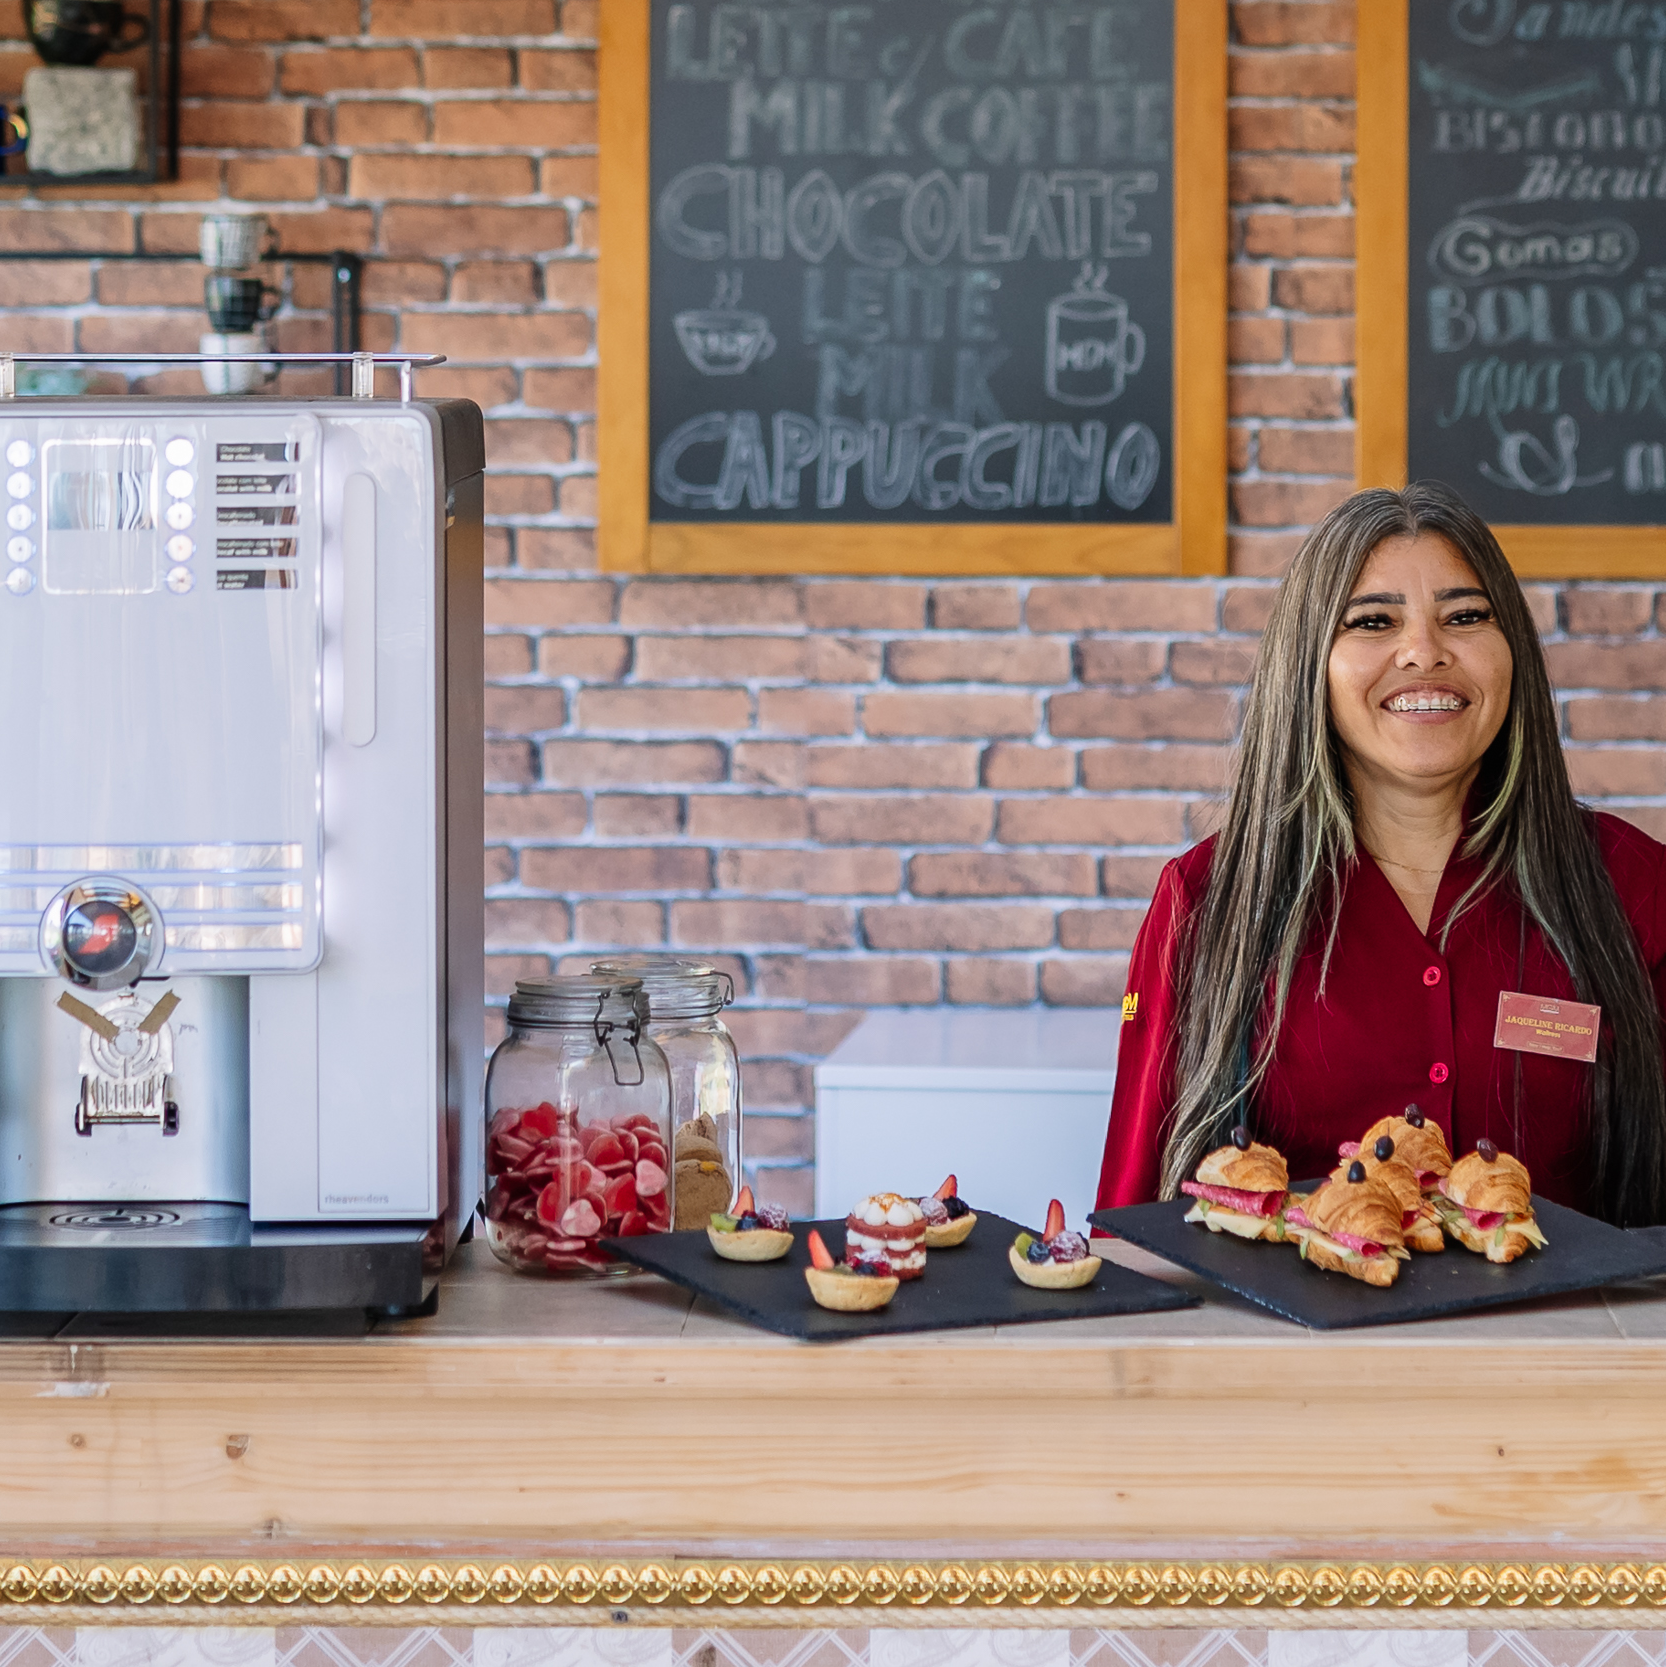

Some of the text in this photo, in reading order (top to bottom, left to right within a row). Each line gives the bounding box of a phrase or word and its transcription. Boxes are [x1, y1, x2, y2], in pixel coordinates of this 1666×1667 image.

[665, 3, 874, 82] LEITE
[729, 75, 1169, 166] MILK COFFEE
[657, 162, 1159, 268] CHOCOLATE
[803, 266, 1001, 344] LEITE
[817, 343, 1011, 422] MILK
[654, 410, 1160, 510] CAPPUCCINO
[1505, 1015, 1593, 1036] JAQUELINE RICARDO
